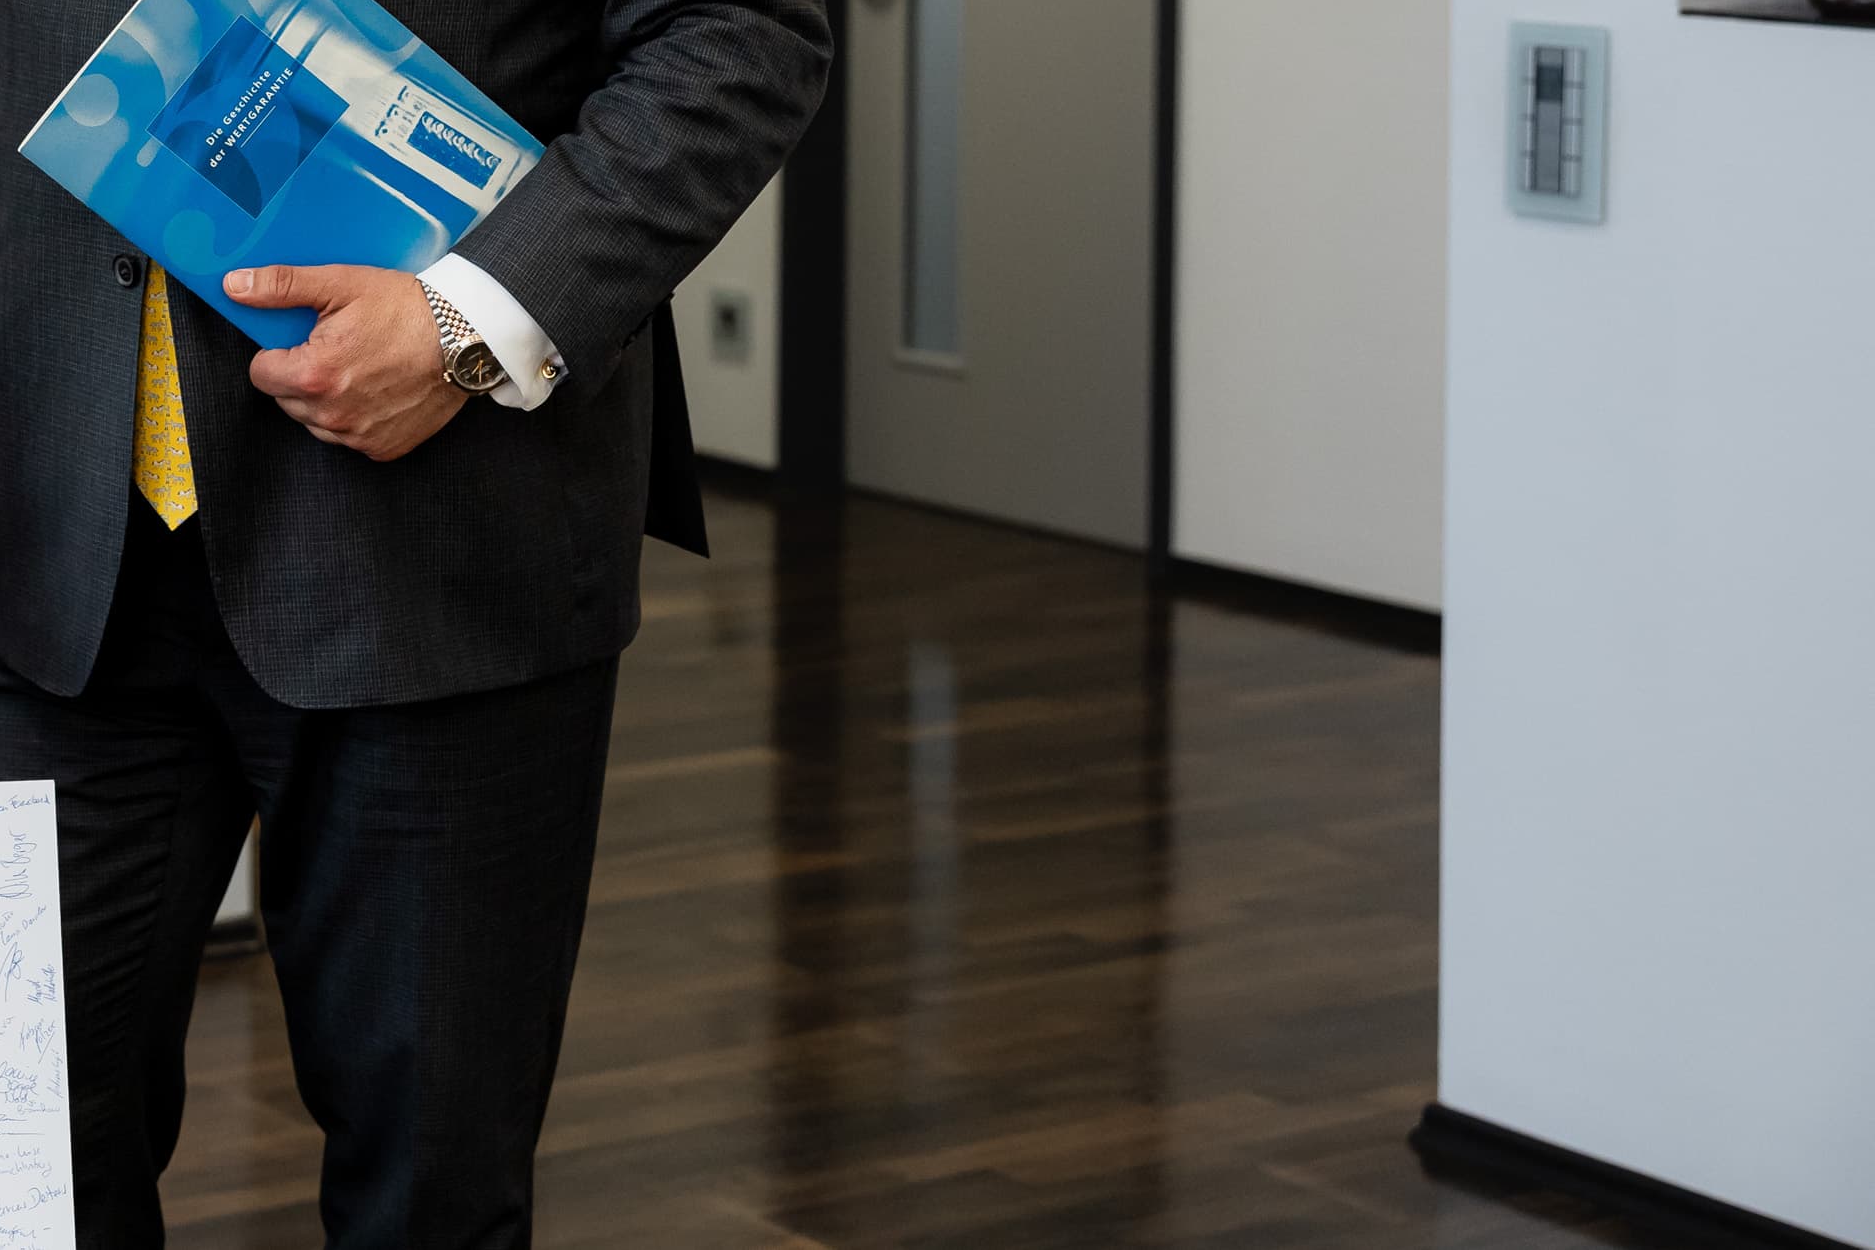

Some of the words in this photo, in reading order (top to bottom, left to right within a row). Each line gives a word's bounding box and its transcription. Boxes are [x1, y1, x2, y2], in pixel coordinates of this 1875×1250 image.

[205, 127, 223, 146] Die
[222, 70, 271, 125] Geschichte
[209, 149, 226, 168] der
[224, 67, 294, 147] WERTGARANTIE
